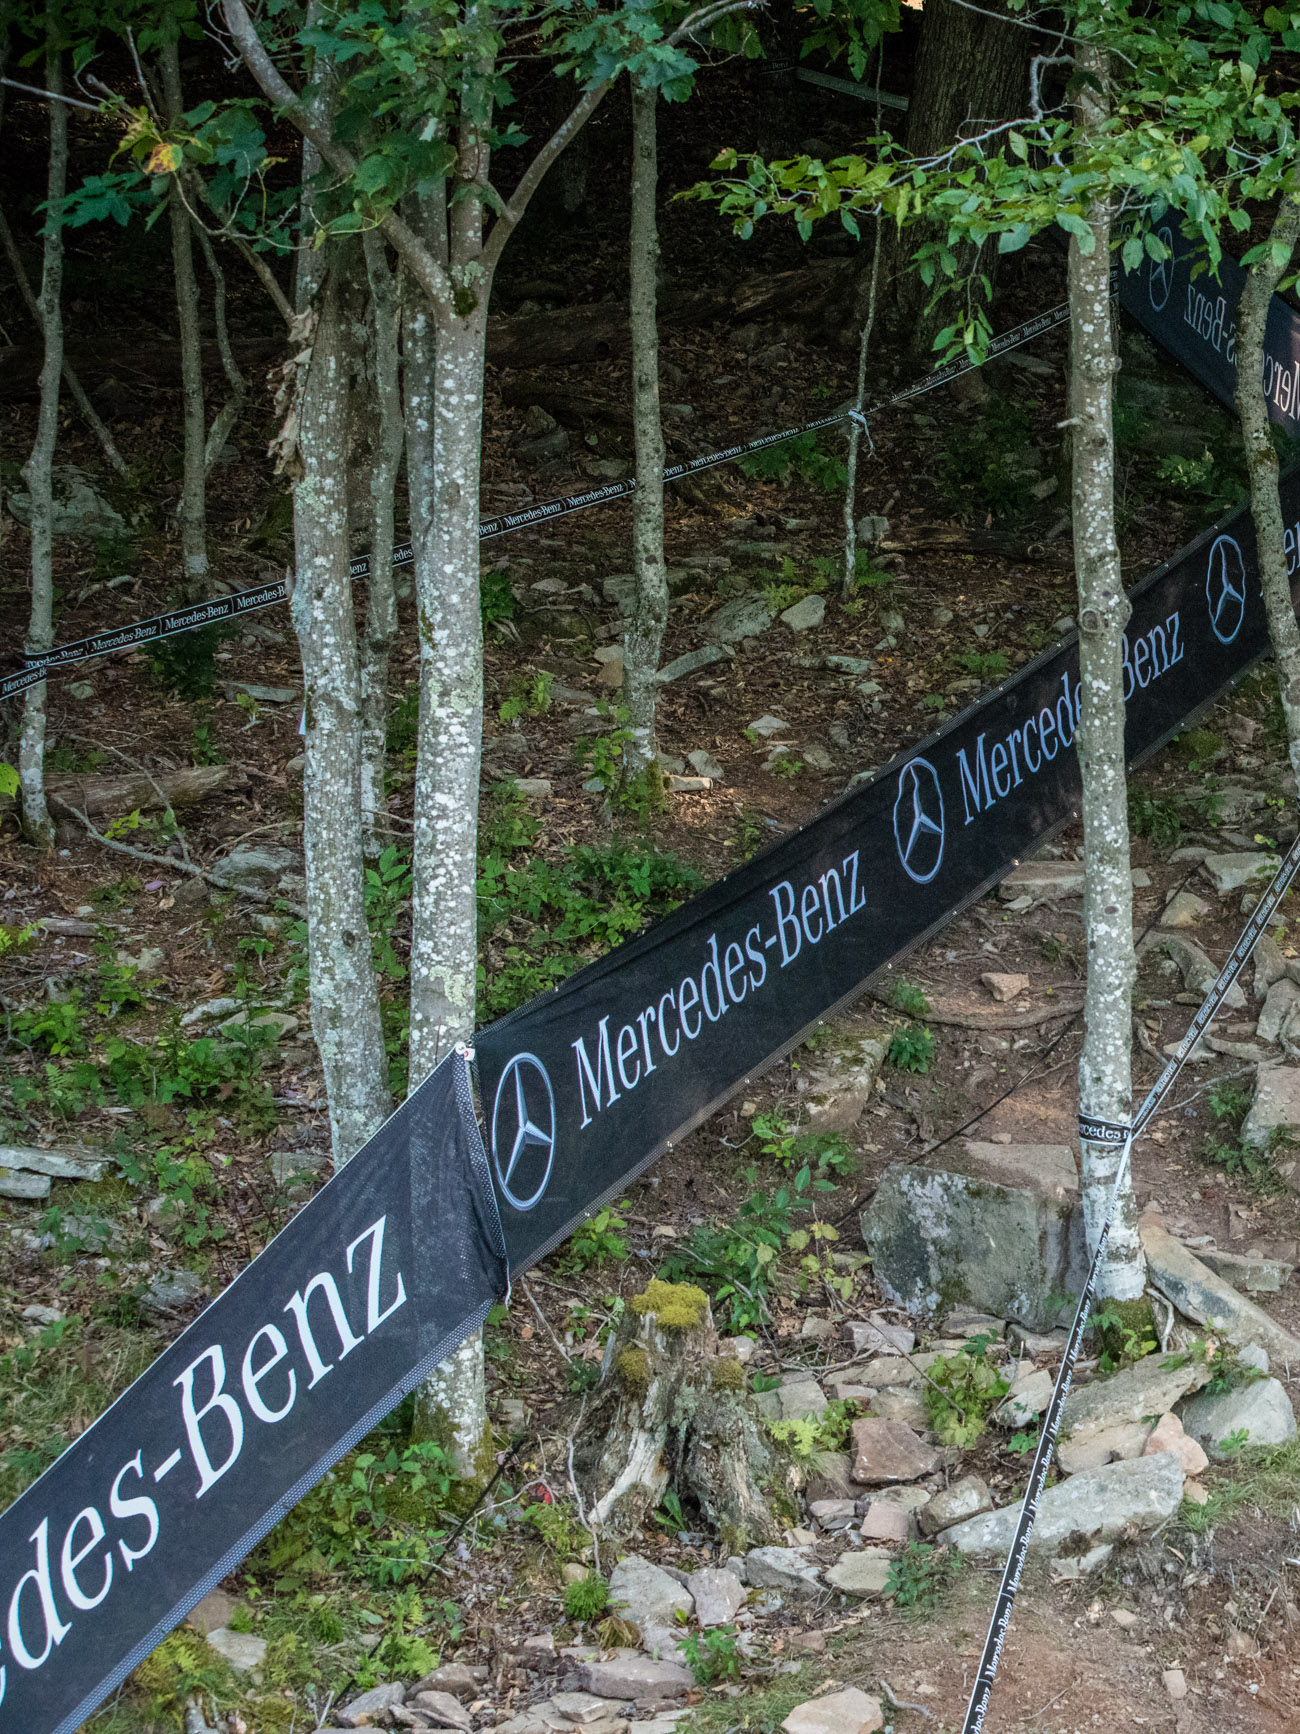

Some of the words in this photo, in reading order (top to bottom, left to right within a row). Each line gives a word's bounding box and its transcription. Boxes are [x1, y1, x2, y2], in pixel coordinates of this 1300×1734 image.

[505, 502, 562, 528] Mercedes-Benz
[568, 482, 624, 507] Mercedes-Benz
[165, 604, 229, 631] Mercedes-Benz
[236, 585, 286, 610] Mercedes-B
[571, 848, 868, 1131] Mercedes-Benz
[0, 1214, 408, 1706] des-Benz
